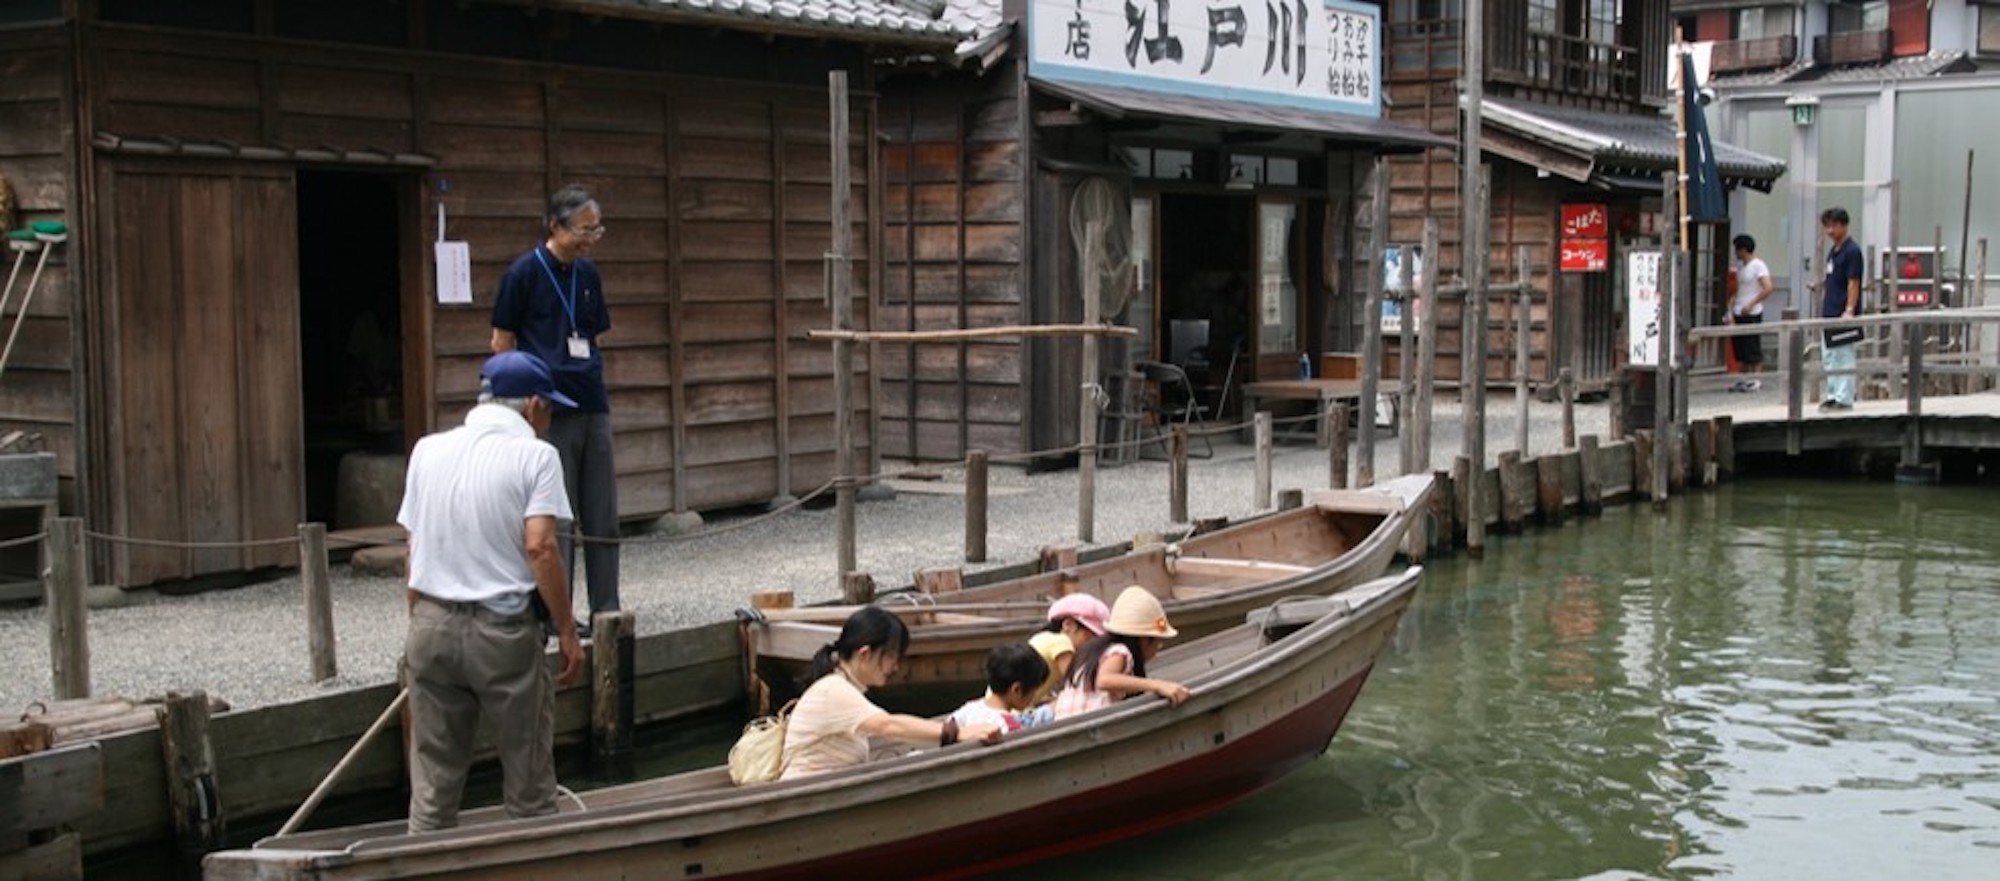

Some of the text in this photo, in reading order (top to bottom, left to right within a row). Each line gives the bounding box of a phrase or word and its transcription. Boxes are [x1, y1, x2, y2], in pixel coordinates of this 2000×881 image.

[1065, 0, 1092, 60] 店
[1125, 0, 1308, 87] 江戸川
